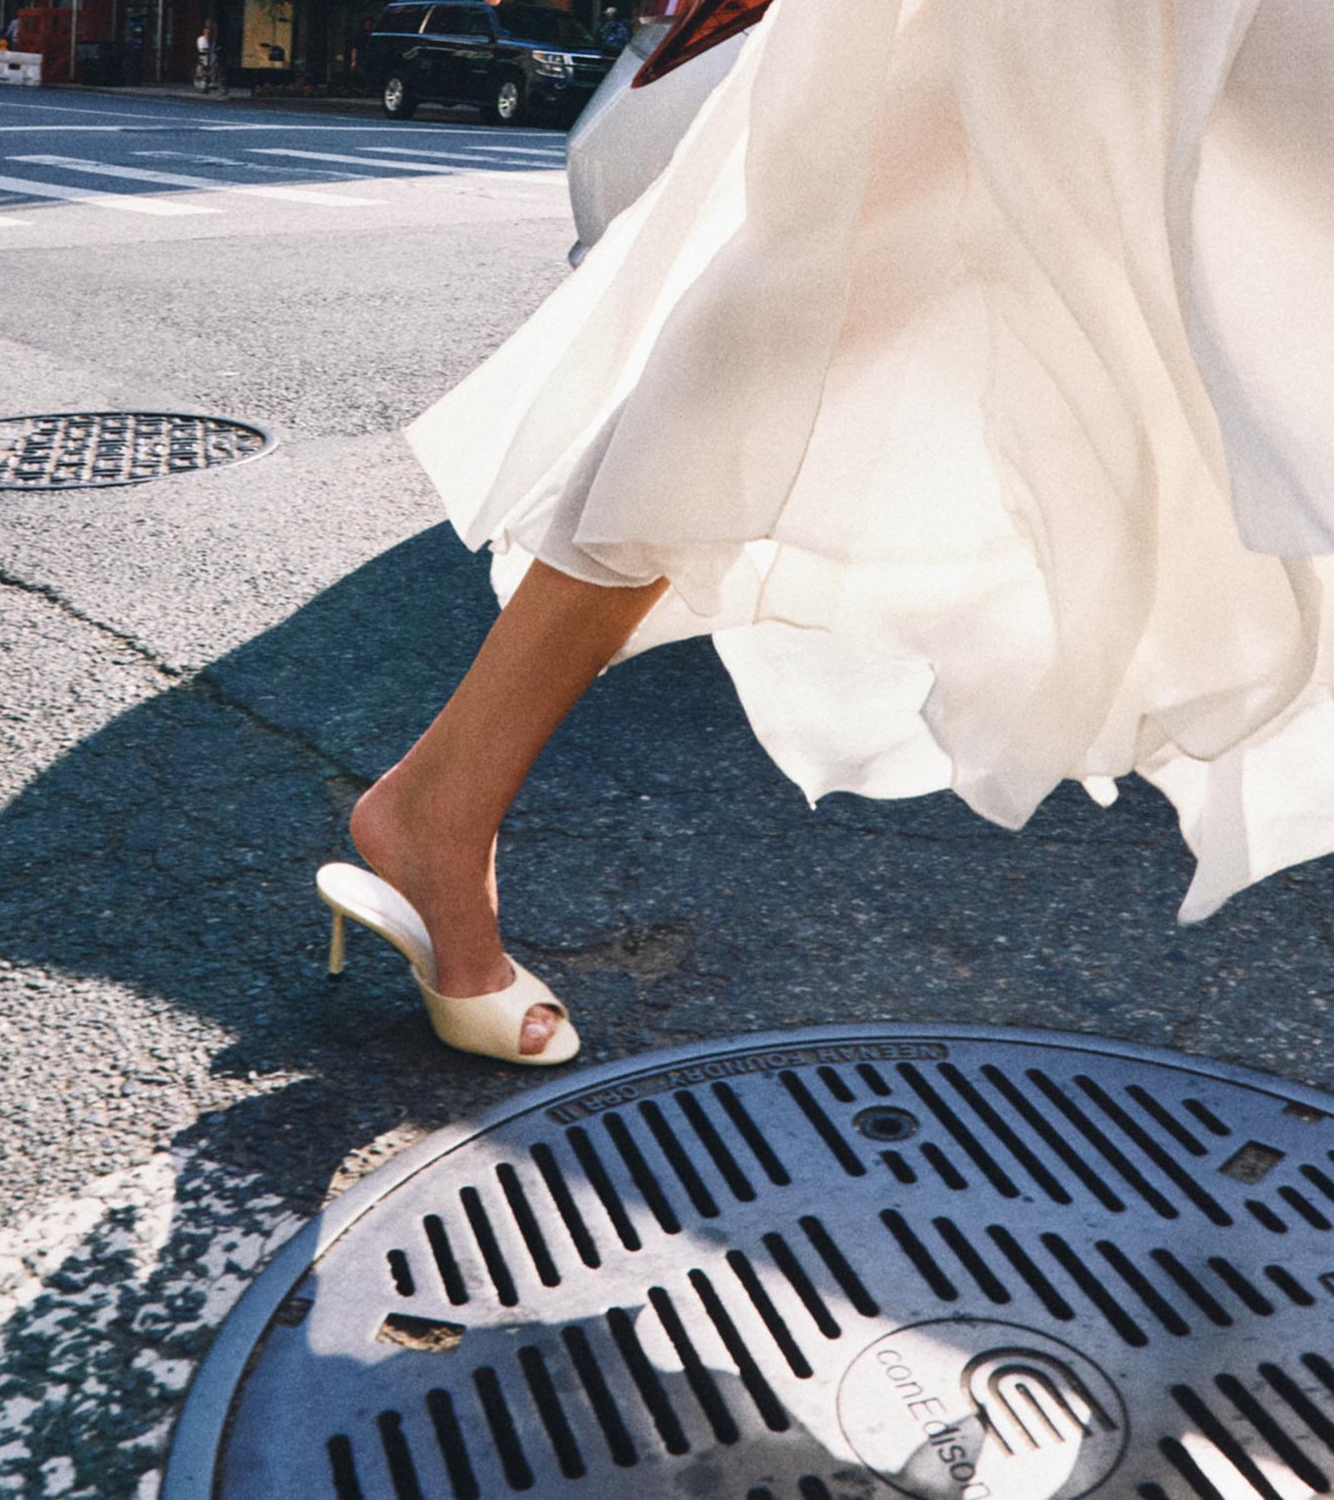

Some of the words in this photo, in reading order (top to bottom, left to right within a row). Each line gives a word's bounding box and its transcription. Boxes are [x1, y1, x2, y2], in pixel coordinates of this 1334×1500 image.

[666, 1051, 805, 1088] FOUNDRY
[815, 1043, 942, 1062] NEENAH
[876, 1349, 992, 1500] conEdison
